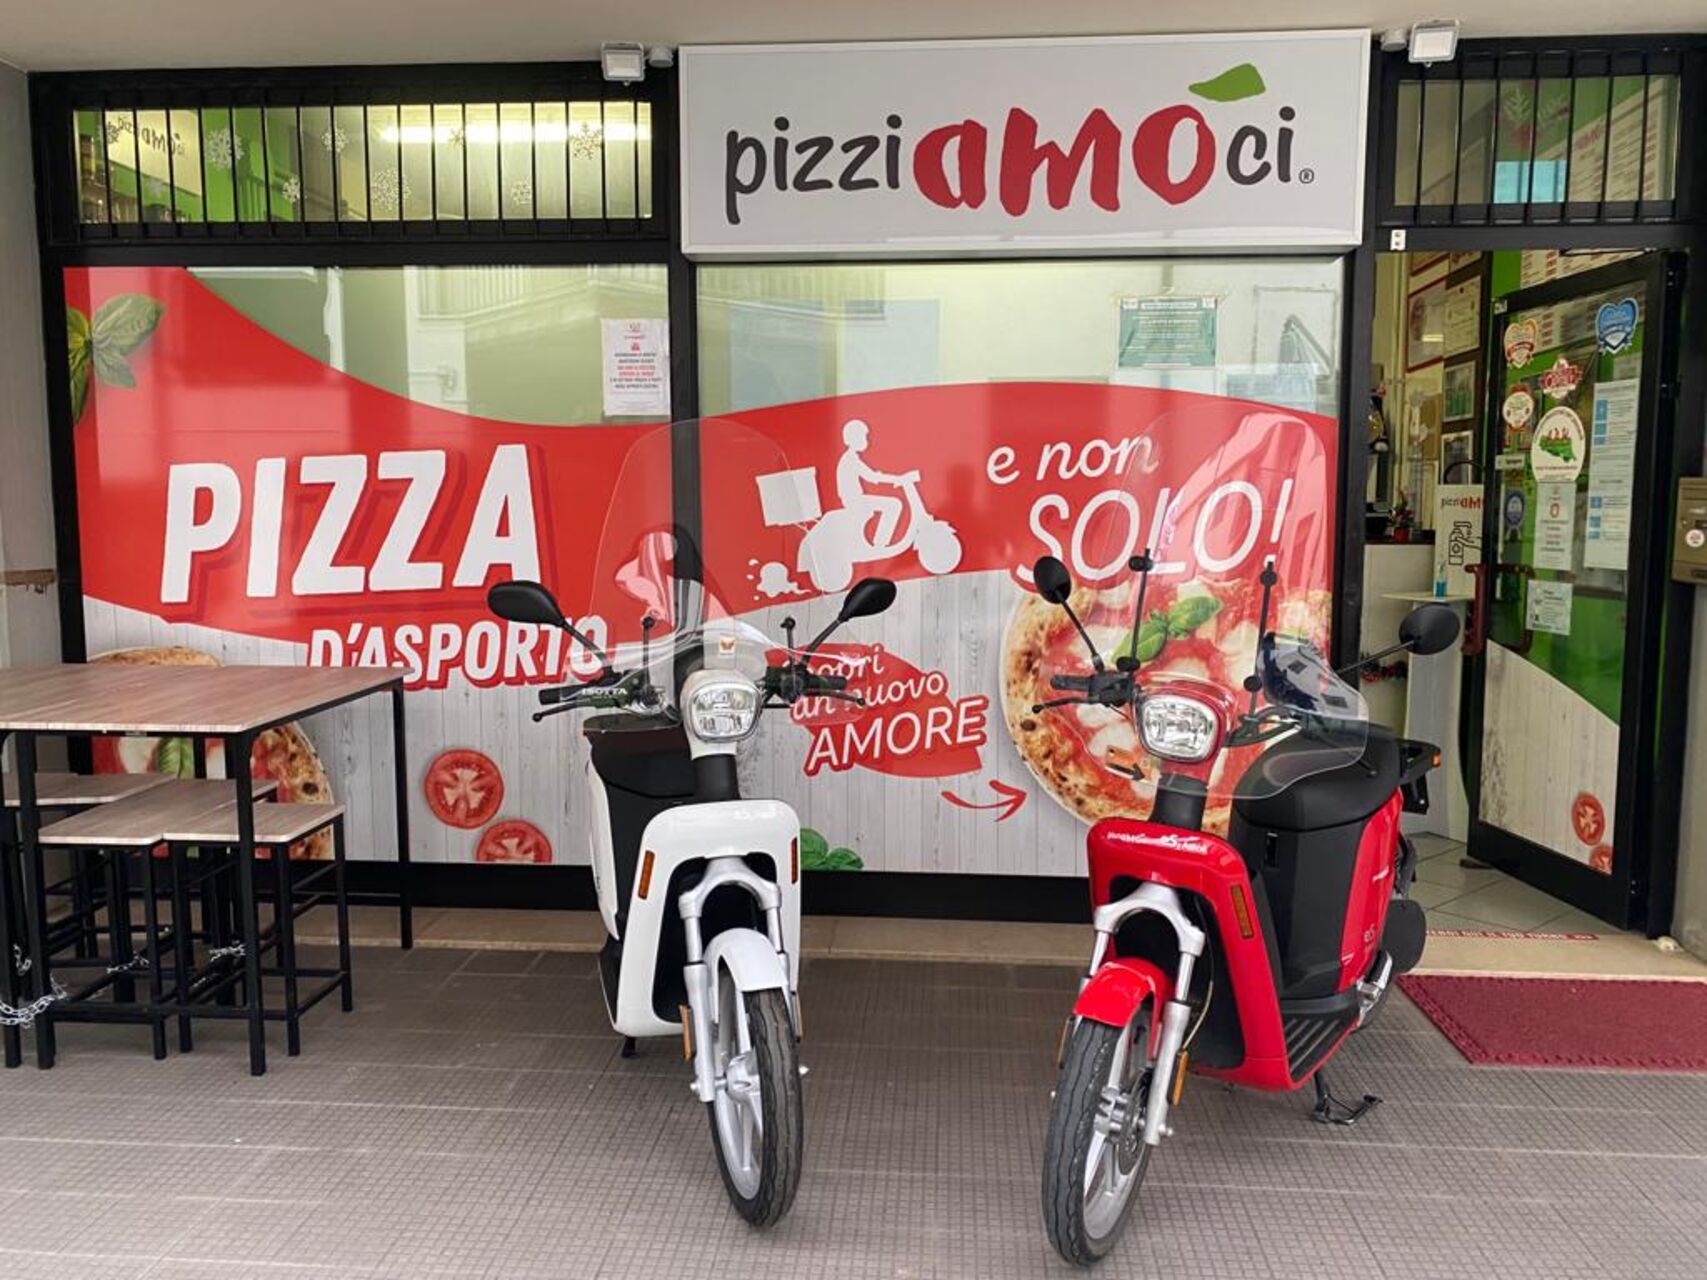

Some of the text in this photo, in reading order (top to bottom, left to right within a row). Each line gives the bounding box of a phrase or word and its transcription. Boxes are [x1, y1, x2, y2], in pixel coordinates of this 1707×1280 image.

[986, 435, 1160, 485] e non
[160, 443, 541, 603] PIZZA
[1015, 478, 1293, 583] SOLO!
[807, 698, 985, 771] AMORE
